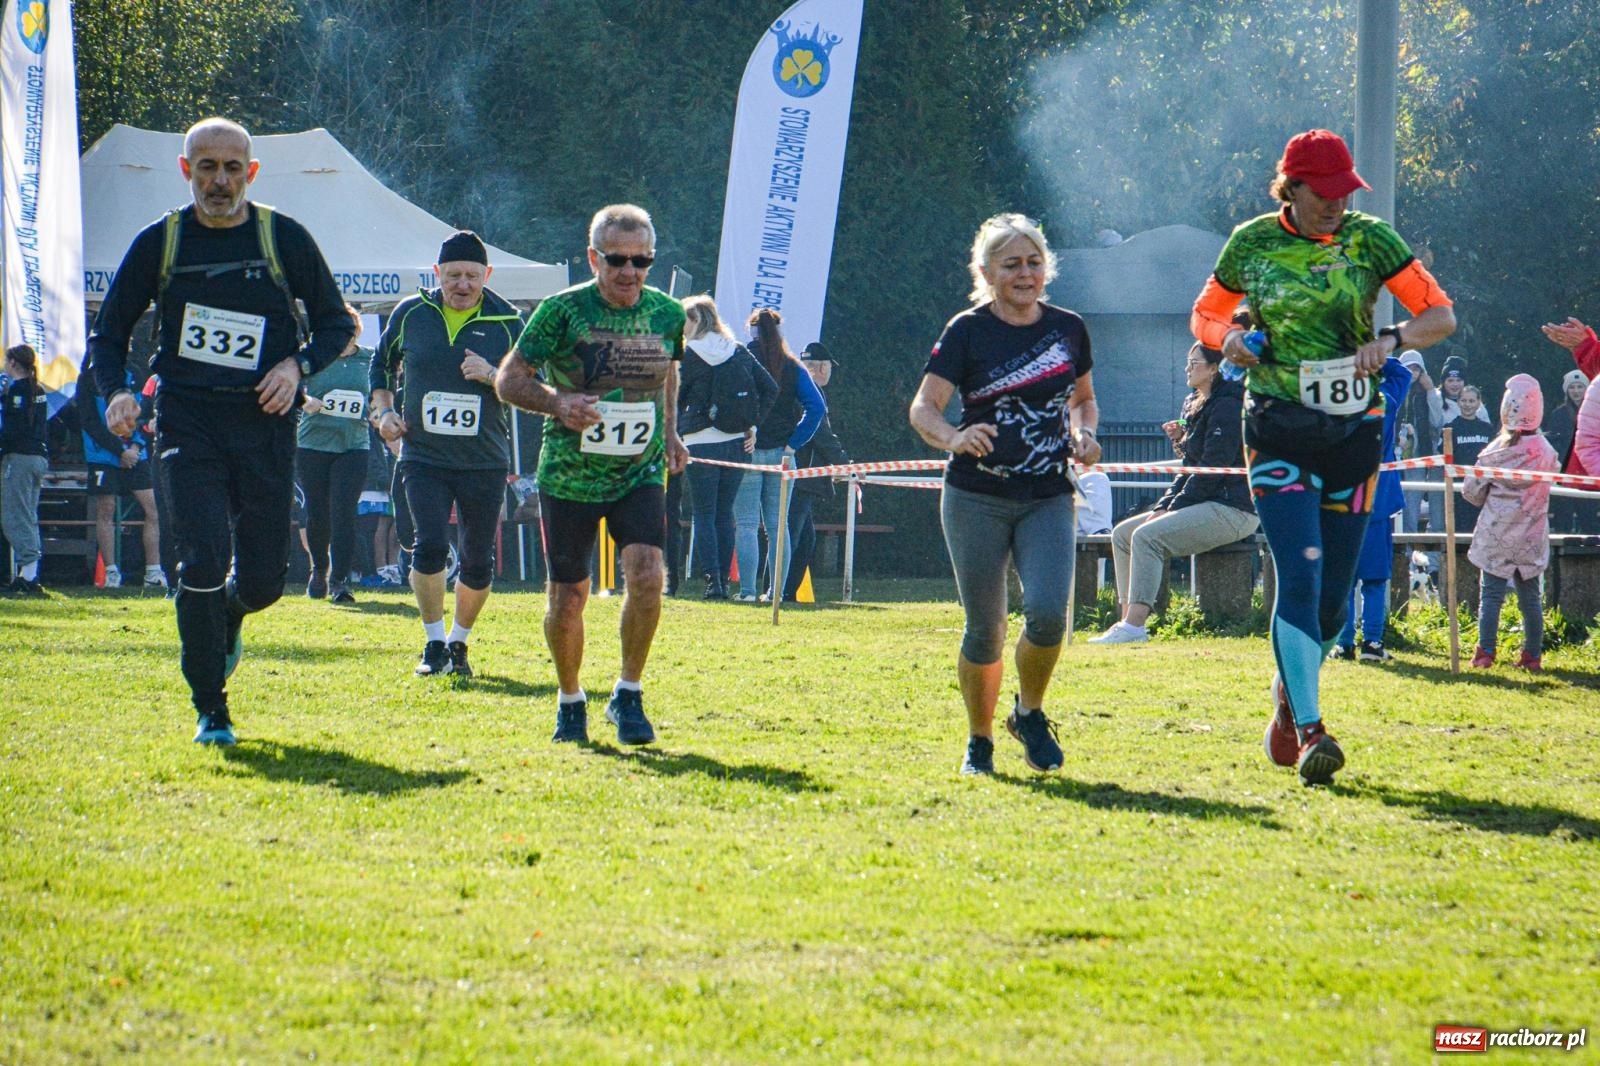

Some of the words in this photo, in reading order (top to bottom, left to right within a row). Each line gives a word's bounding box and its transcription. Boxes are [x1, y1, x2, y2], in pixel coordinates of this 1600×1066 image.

[769, 107, 811, 202] STOWARZYSZENIE
[760, 203, 796, 255] AKTYWNI
[756, 256, 788, 278] DLA
[333, 273, 401, 295] EPSZEGO
[751, 282, 784, 312] LEPS
[186, 324, 257, 360] 332
[1306, 378, 1366, 404] 180
[324, 398, 361, 414] 318
[426, 406, 476, 428] 149
[586, 421, 650, 445] 312
[95, 470, 105, 487] 7
